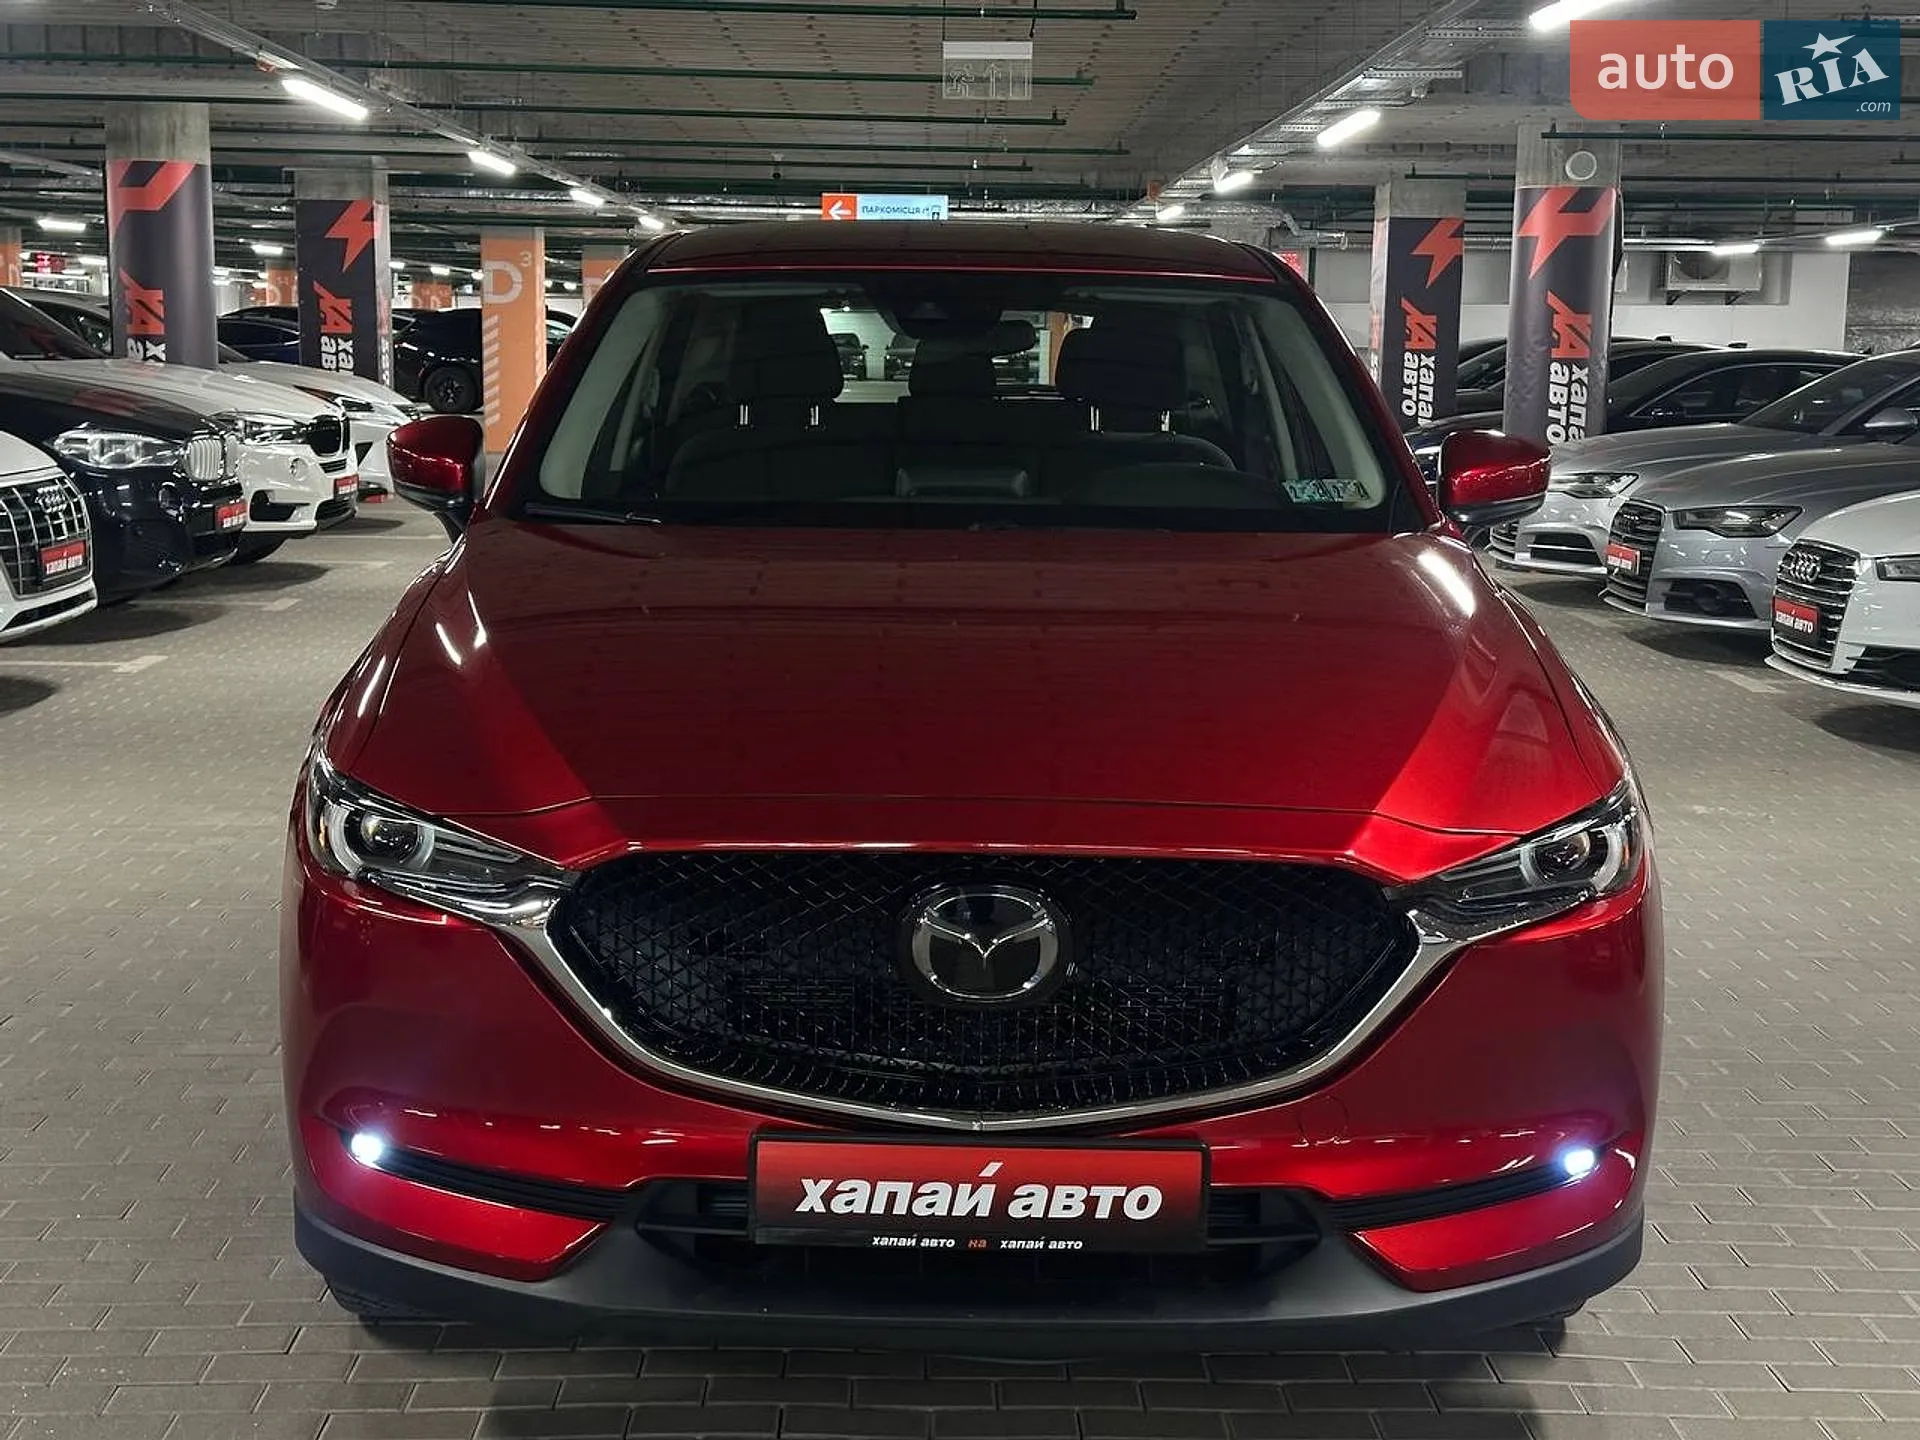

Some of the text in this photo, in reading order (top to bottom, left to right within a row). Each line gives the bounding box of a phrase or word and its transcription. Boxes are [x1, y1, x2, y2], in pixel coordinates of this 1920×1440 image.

[1401, 351, 1418, 416] авто
[1546, 361, 1570, 444] авто
[795, 1161, 1163, 1220] хапай авто
[872, 1233, 1083, 1250] хапай авто на хапай авто
